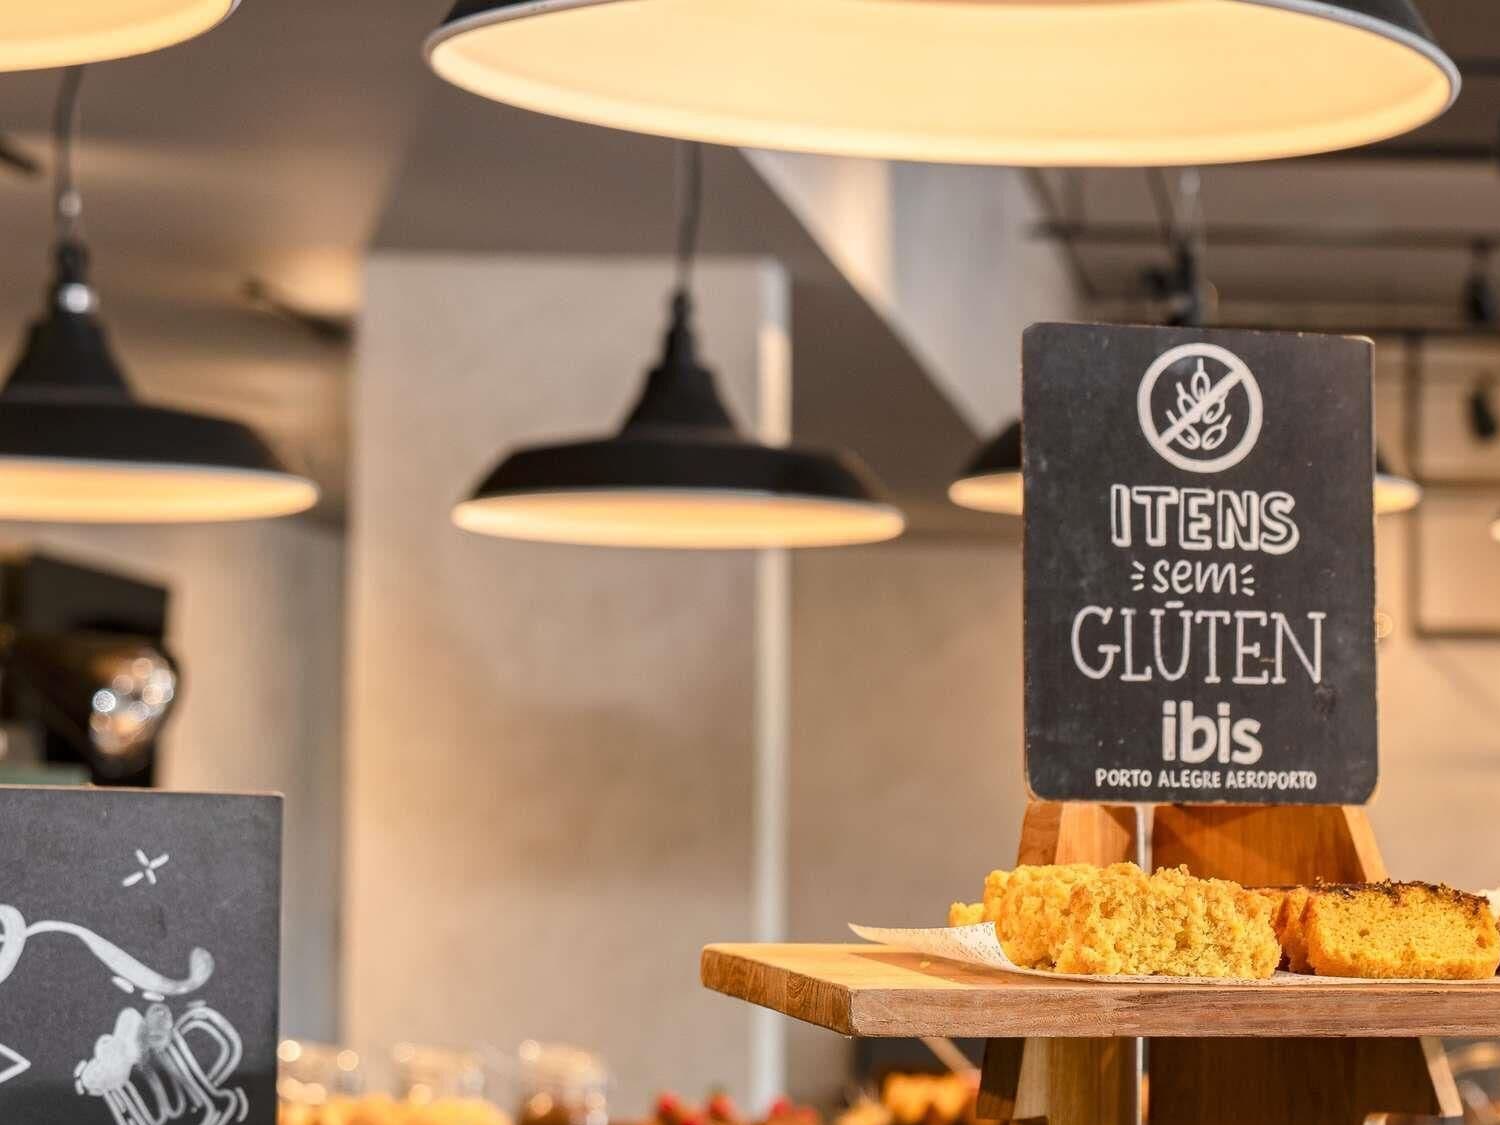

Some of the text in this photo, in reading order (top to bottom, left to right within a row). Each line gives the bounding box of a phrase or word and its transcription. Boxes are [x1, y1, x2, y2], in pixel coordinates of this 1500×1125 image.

[1110, 483, 1300, 555] ITENS
[1152, 558, 1237, 595] sem
[1162, 699, 1263, 765] ibis
[1095, 767, 1317, 790] PORTO ALEGRE AEROPORTO
